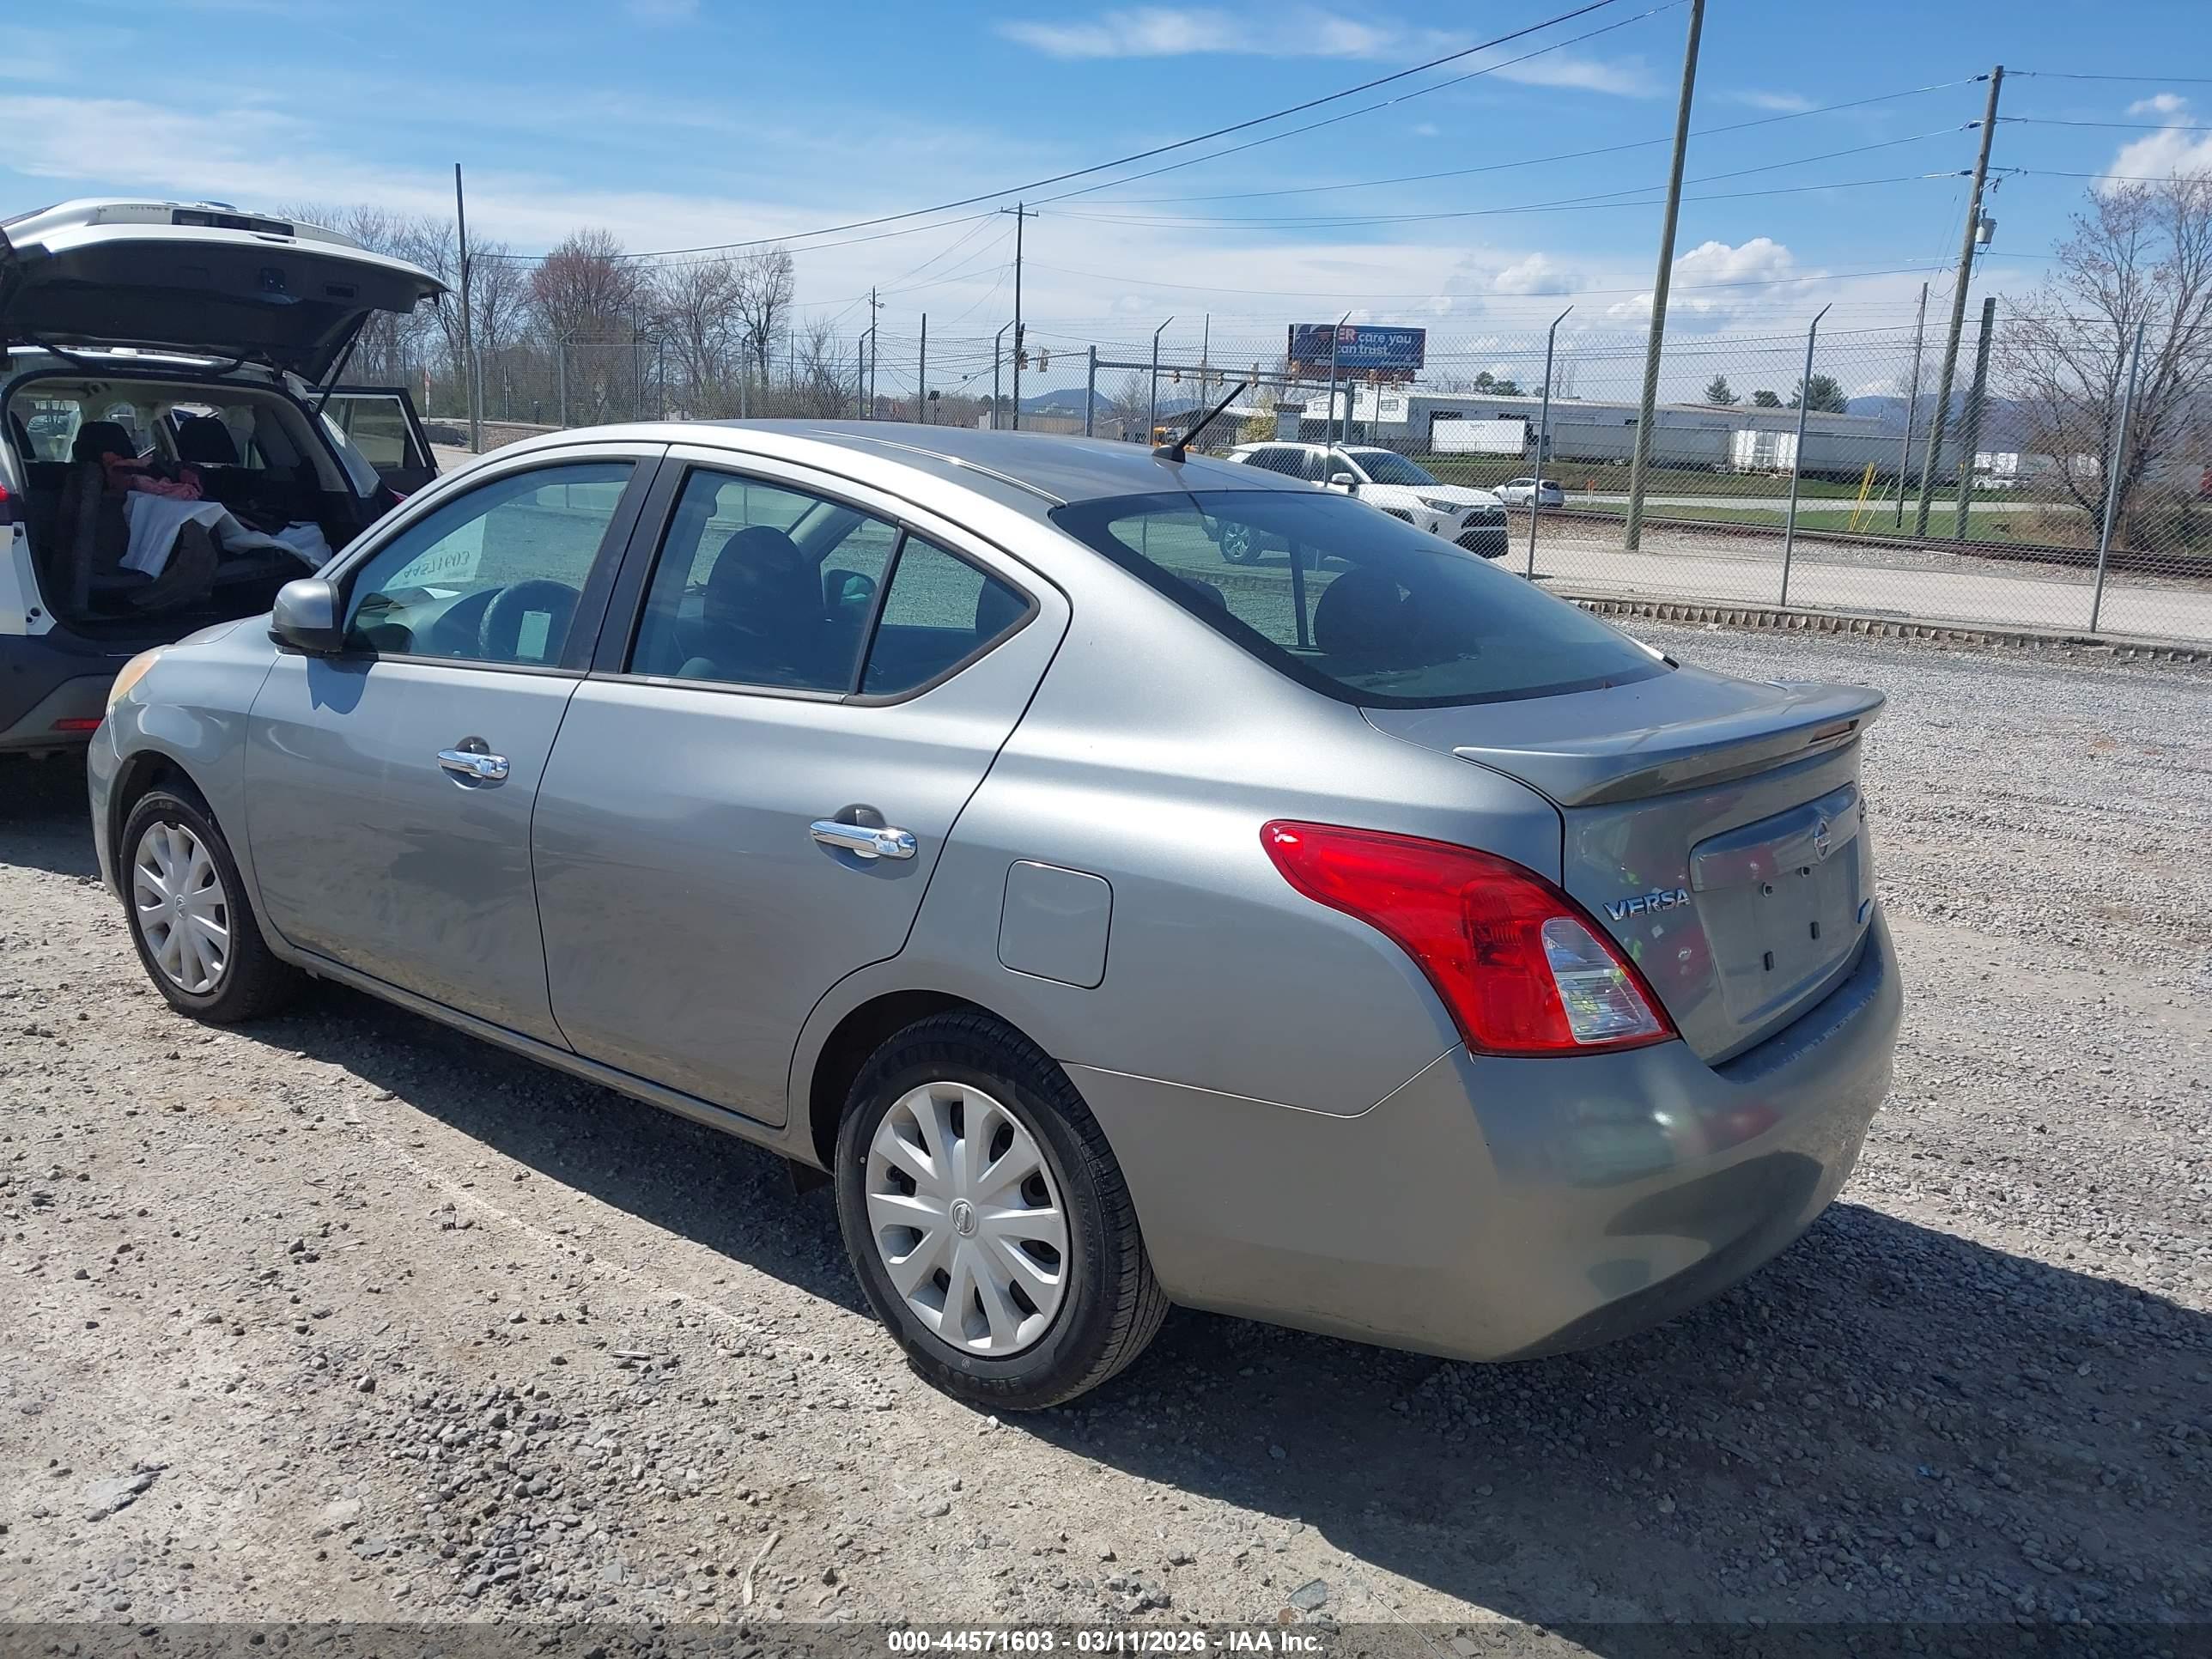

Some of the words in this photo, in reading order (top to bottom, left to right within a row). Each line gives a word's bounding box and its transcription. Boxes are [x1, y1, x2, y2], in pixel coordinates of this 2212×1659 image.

[1358, 333, 1386, 343] care
[1389, 334, 1412, 346] you
[1601, 887, 1691, 921] VERSA
